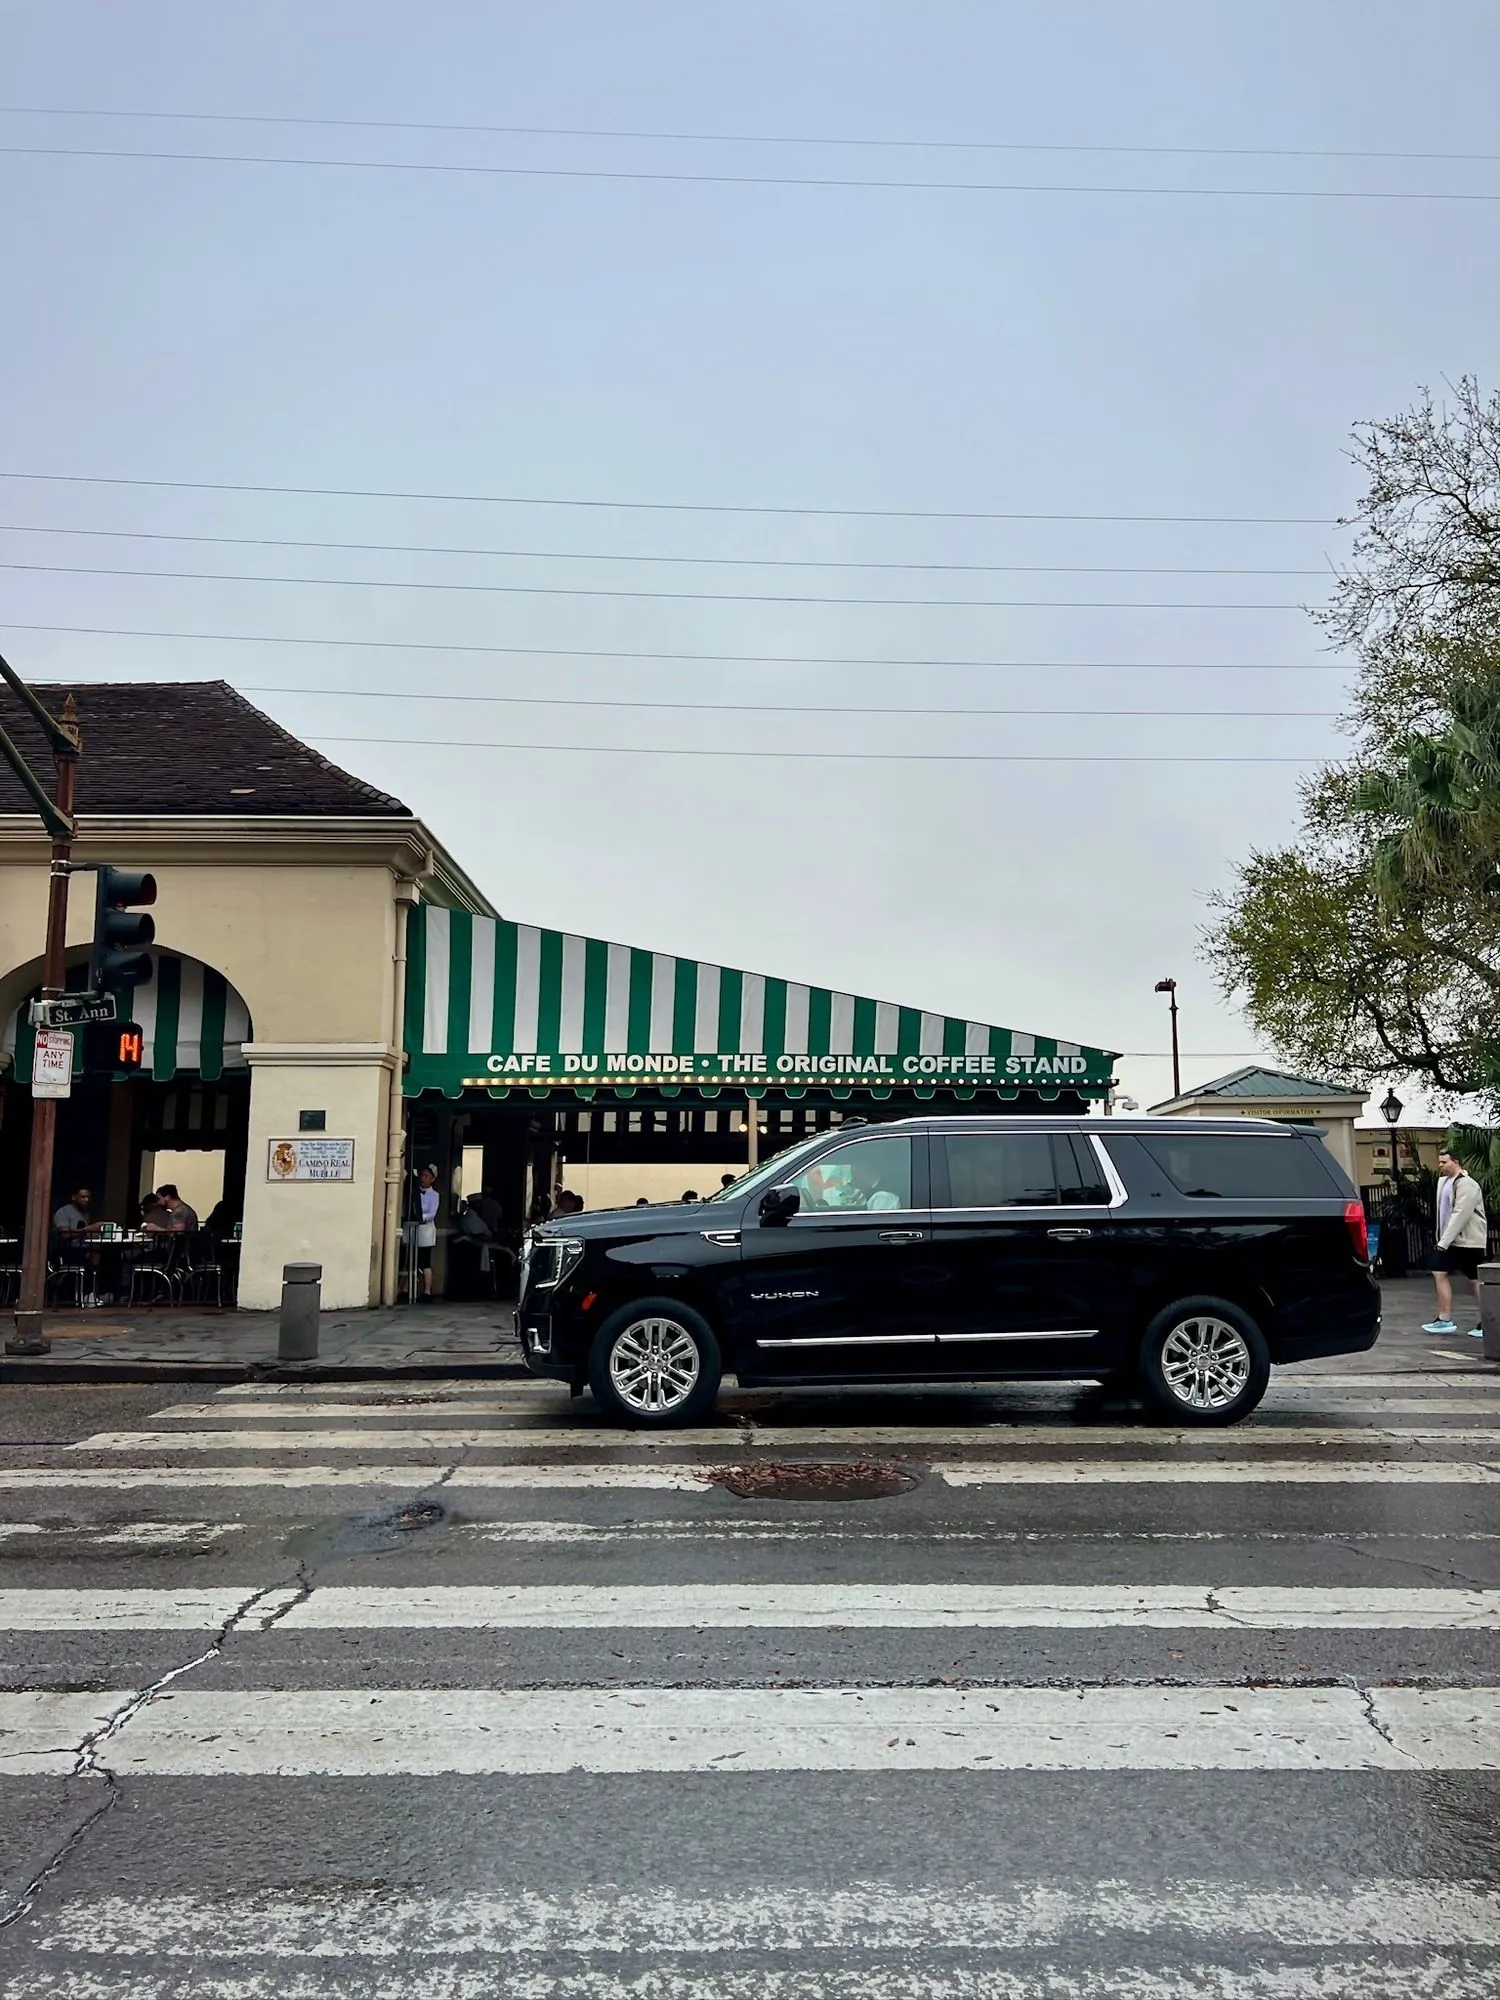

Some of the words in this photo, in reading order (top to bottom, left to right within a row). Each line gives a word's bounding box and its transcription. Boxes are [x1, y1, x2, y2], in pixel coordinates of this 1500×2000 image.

[55, 1009, 73, 1022] St.
[80, 1007, 109, 1020] Ann
[38, 1033, 48, 1046] NO
[43, 1050, 65, 1060] ANY
[43, 1059, 64, 1069] TIME
[487, 1055, 551, 1073] CAFE
[564, 1055, 599, 1073] DU
[606, 1055, 694, 1073] MONDE
[717, 1055, 767, 1073] THE
[776, 1055, 893, 1074] ORIGINAL
[902, 1056, 996, 1074] COFFEE
[1005, 1056, 1088, 1074] STAND
[1247, 1108, 1271, 1116] VISITOR
[1272, 1107, 1315, 1116] INFORMATION
[299, 1159, 329, 1167] CAMINO
[330, 1159, 350, 1168] REAL
[309, 1169, 340, 1178] MUELLE
[750, 1290, 819, 1300] YUKON
